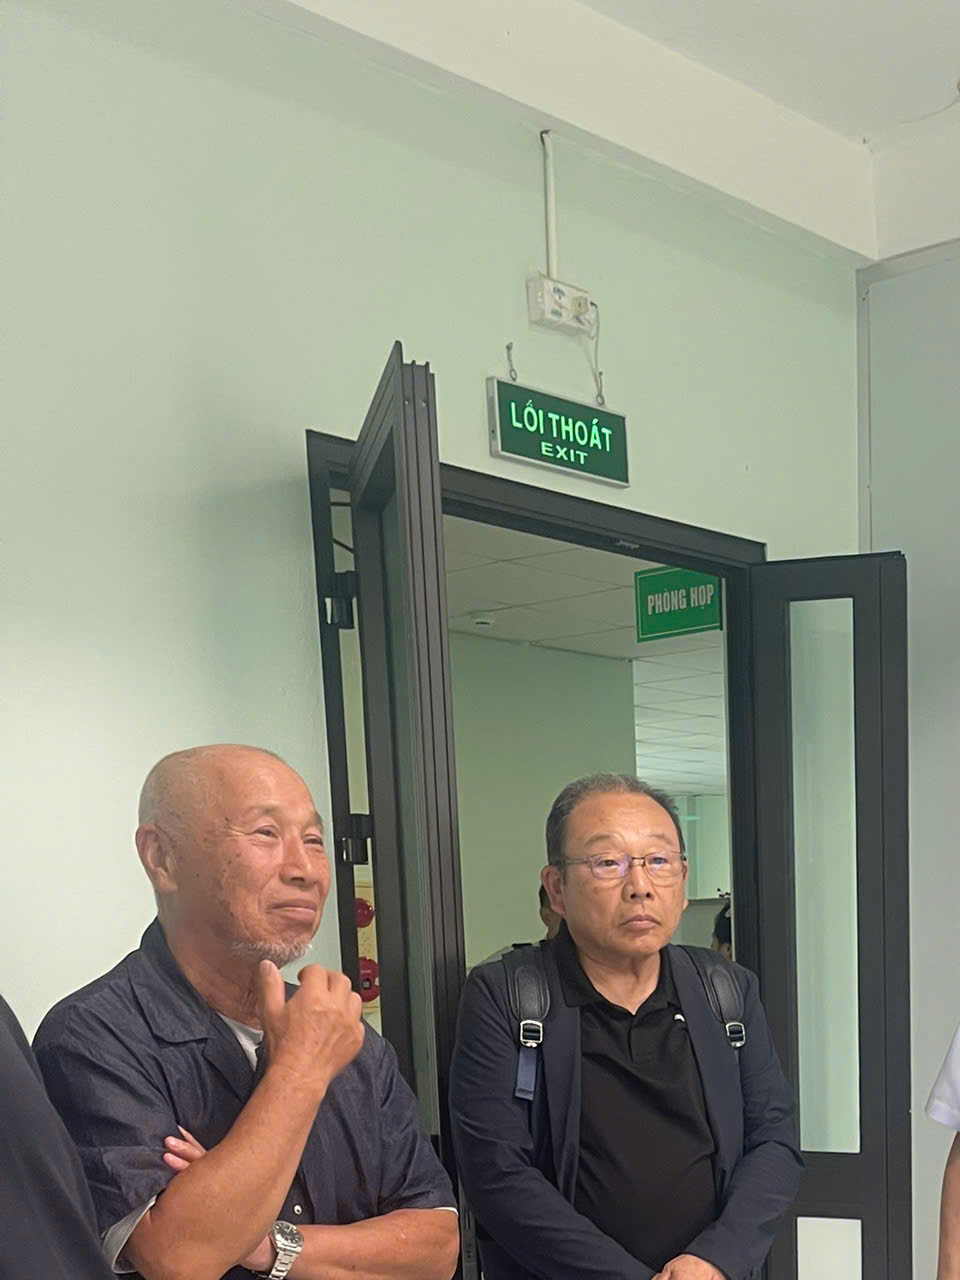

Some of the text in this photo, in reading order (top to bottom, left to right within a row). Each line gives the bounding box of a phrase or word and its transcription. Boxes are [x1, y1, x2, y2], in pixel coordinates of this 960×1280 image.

[510, 399, 612, 452] LỐI THOÁT
[541, 441, 588, 465] EXIT
[647, 584, 714, 616] PHÒNG HỌP
